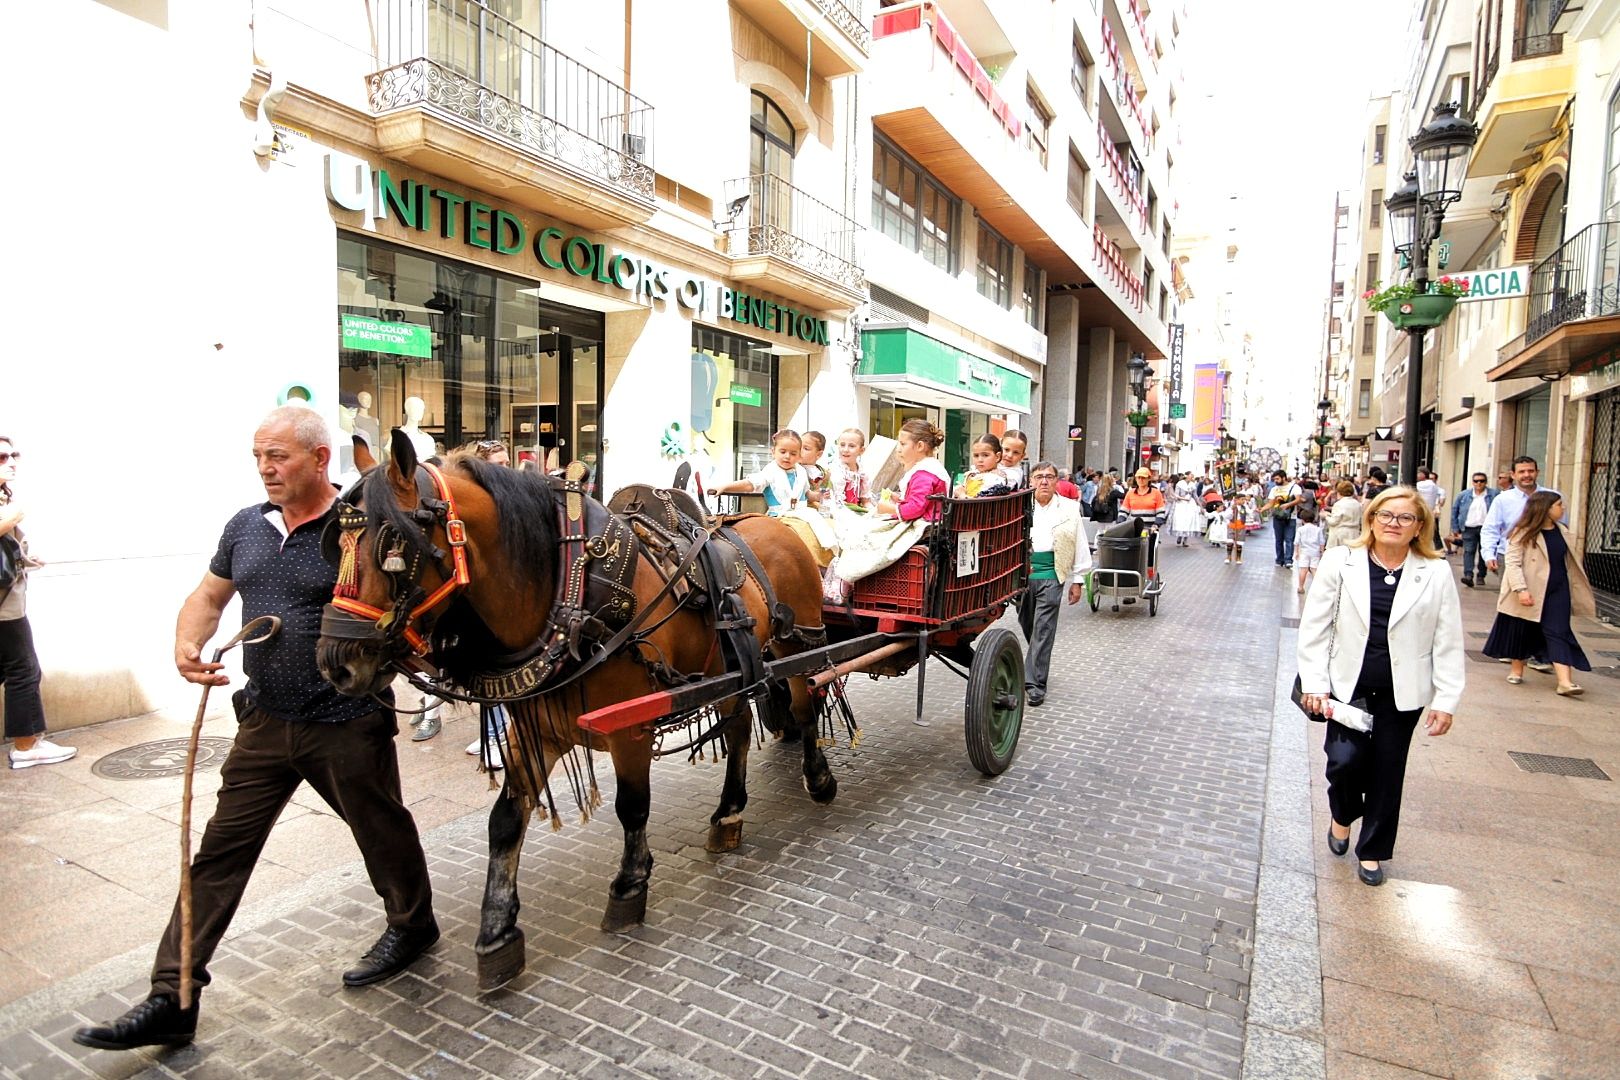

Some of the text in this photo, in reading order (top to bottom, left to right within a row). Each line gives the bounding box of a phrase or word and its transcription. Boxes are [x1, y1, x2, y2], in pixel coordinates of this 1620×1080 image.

[323, 153, 527, 256] UNITED
[532, 226, 670, 300] COLORS
[345, 319, 413, 336] UNITED COLORS
[345, 328, 358, 337] OF
[1172, 328, 1183, 399] FARMACIA
[970, 536, 976, 571] 3
